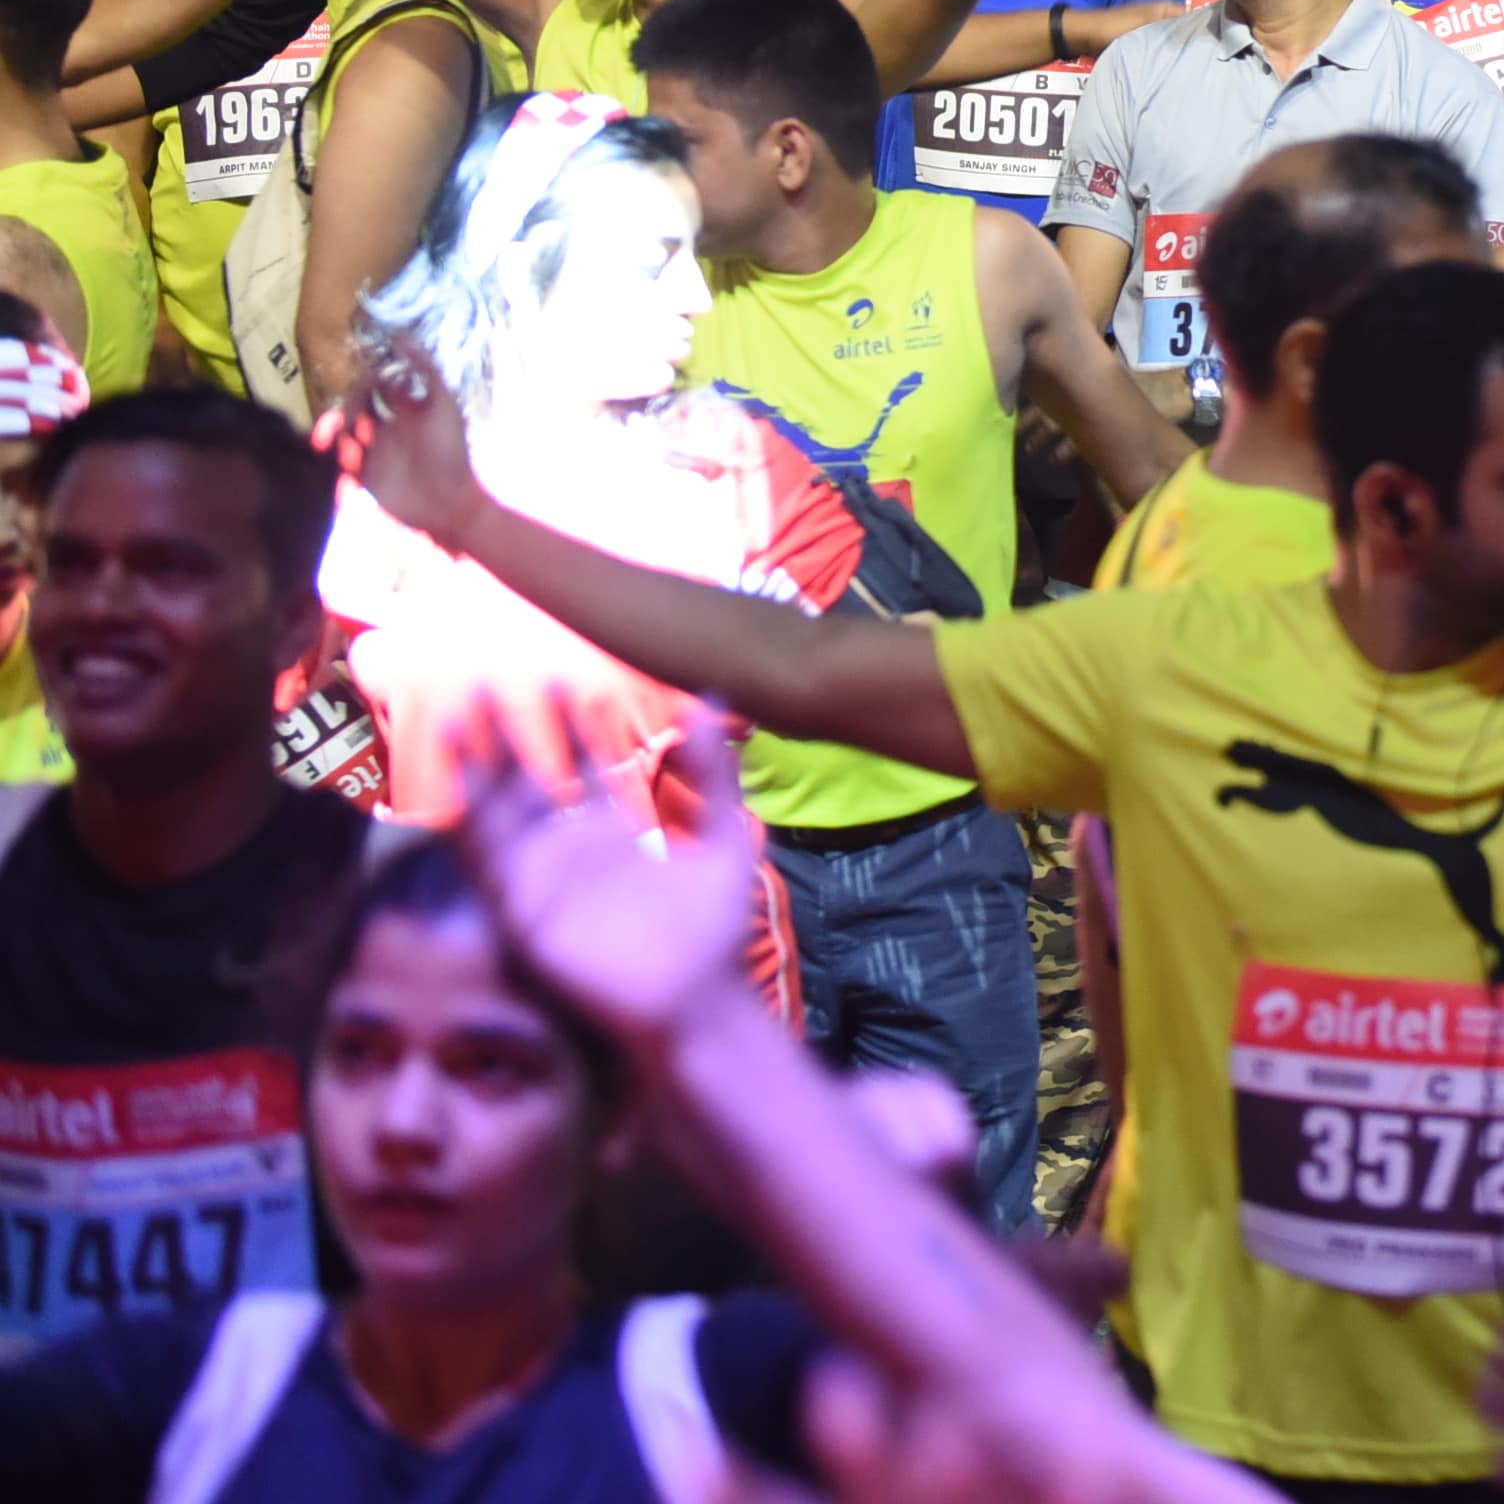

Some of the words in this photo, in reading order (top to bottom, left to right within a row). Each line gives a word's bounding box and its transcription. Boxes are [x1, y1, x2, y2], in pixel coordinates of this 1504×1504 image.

[296, 61, 313, 79] D
[1035, 74, 1050, 90] B
[932, 90, 1078, 147] 20501
[219, 163, 246, 175] ARPIT
[959, 159, 998, 172] SANJAY
[1001, 163, 1037, 174] SINGH
[833, 336, 894, 360] airtel
[1303, 991, 1448, 1053] airtel
[1426, 1073, 1454, 1104] C
